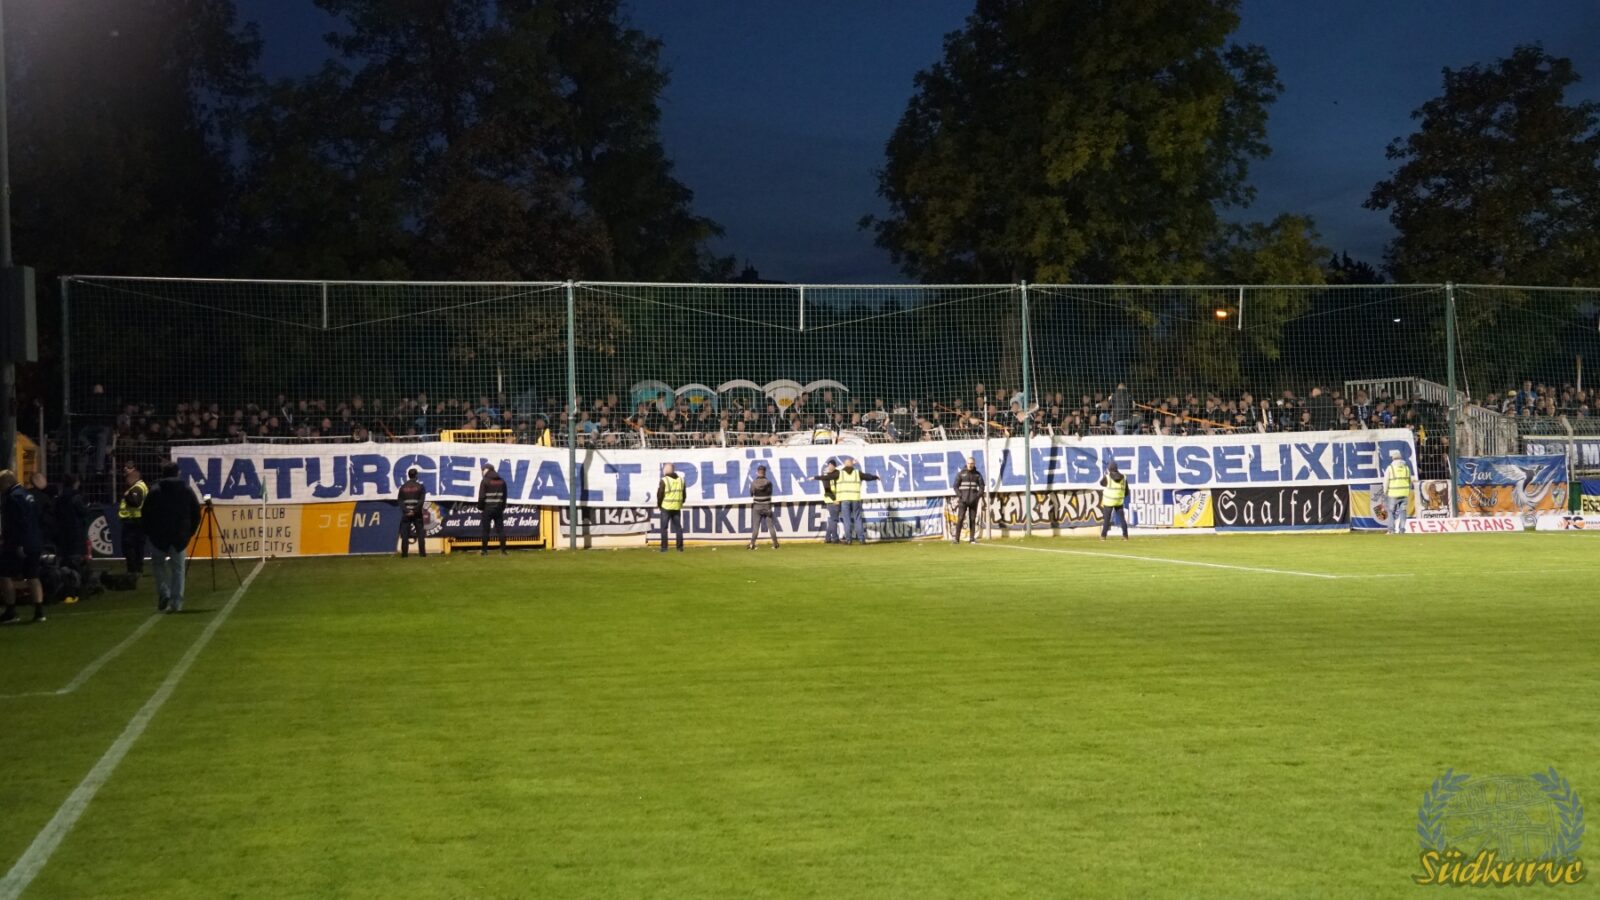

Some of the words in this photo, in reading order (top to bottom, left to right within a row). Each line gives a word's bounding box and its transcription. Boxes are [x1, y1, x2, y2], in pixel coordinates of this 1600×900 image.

[177, 454, 651, 503] NATURGEWALT,
[1000, 440, 1415, 487] LEBENSELIXIER
[232, 509, 254, 521] FAN
[257, 507, 286, 520] CLUB
[982, 489, 1104, 524] HARAKIR
[1217, 489, 1344, 526] Saalfeld
[319, 511, 381, 529] JENA
[1409, 520, 1448, 532] FLEX
[1462, 518, 1515, 531] TRANS
